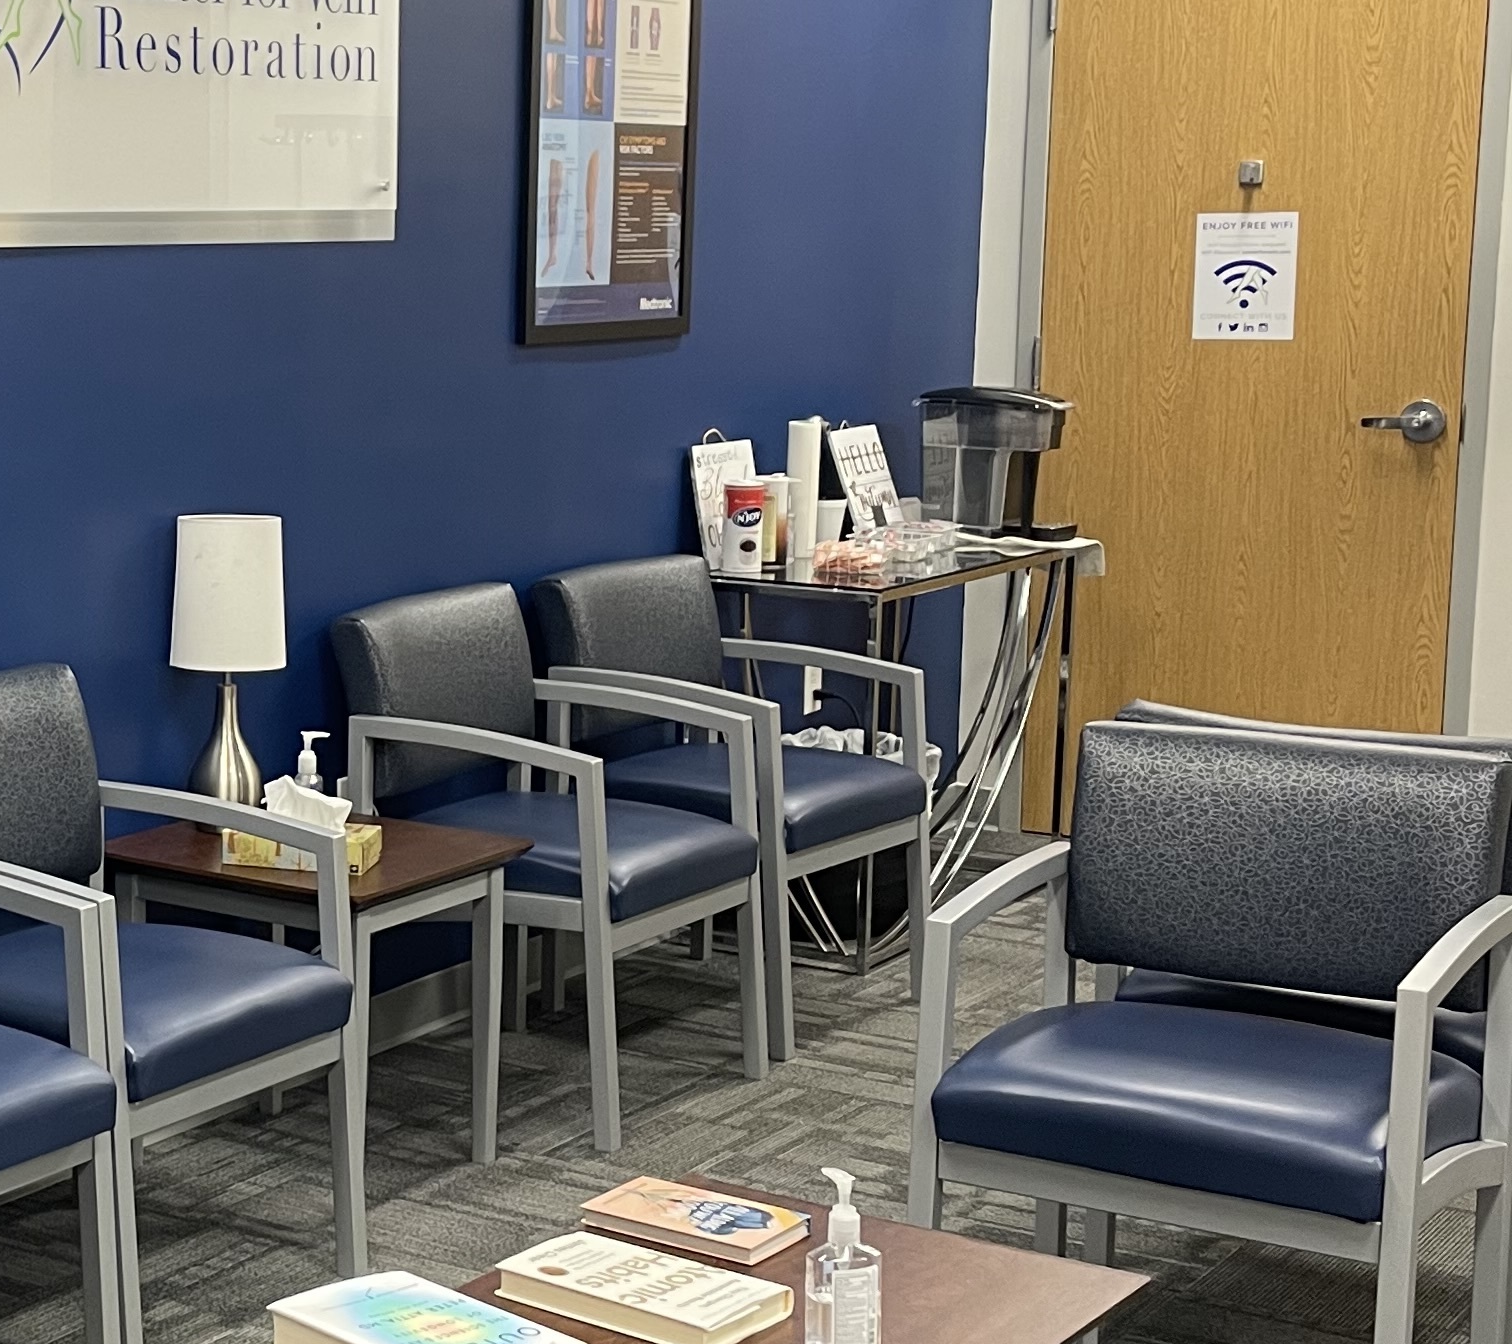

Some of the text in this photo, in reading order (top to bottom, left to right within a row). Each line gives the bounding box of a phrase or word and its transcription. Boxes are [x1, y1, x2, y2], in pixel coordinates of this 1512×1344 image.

[94, 5, 379, 83] Restoration
[1202, 222, 1237, 231] ENJOY
[1240, 221, 1267, 230] FREE
[838, 441, 885, 478] HELLO
[575, 1251, 679, 1289] Habits
[618, 1264, 727, 1305] Atomic
[428, 1298, 468, 1312] PETER
